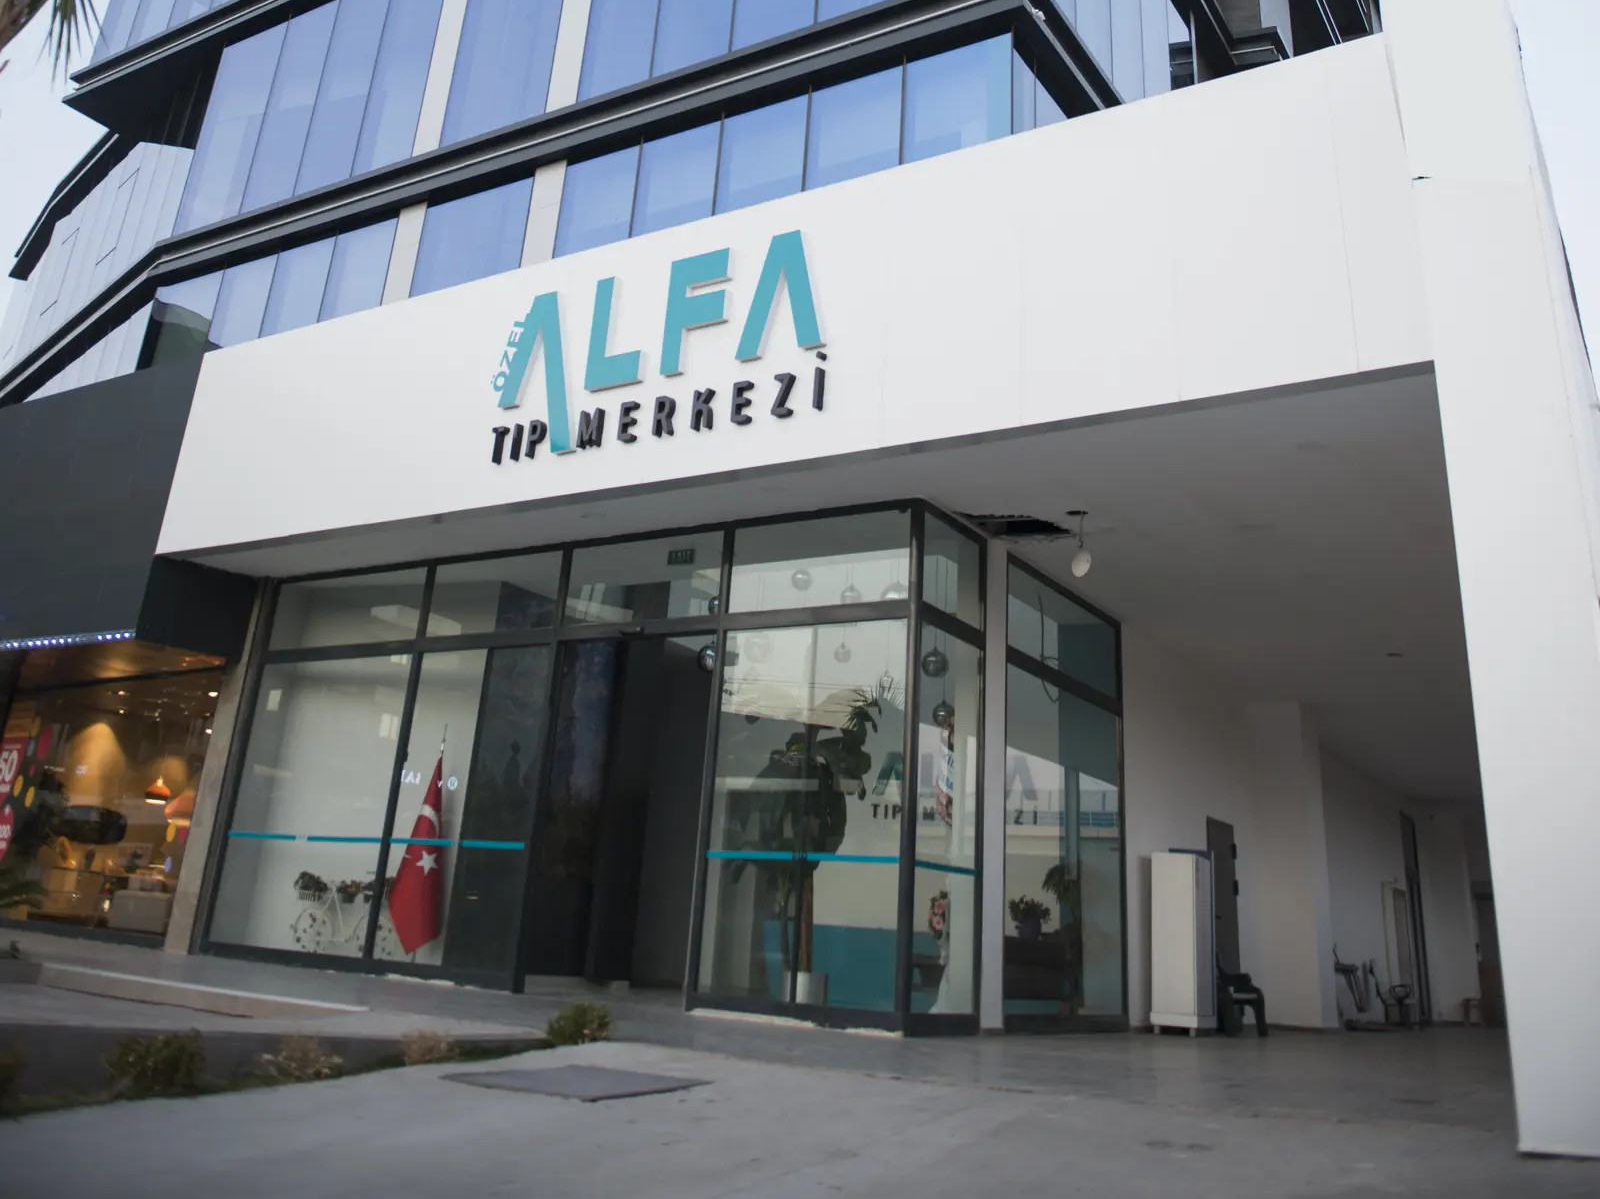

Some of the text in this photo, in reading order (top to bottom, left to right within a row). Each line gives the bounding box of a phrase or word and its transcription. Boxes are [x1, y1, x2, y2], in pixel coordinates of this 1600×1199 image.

[491, 309, 531, 392] ÖZEL
[498, 229, 826, 455] ALFA
[492, 351, 827, 465] TIP MERKEZİ
